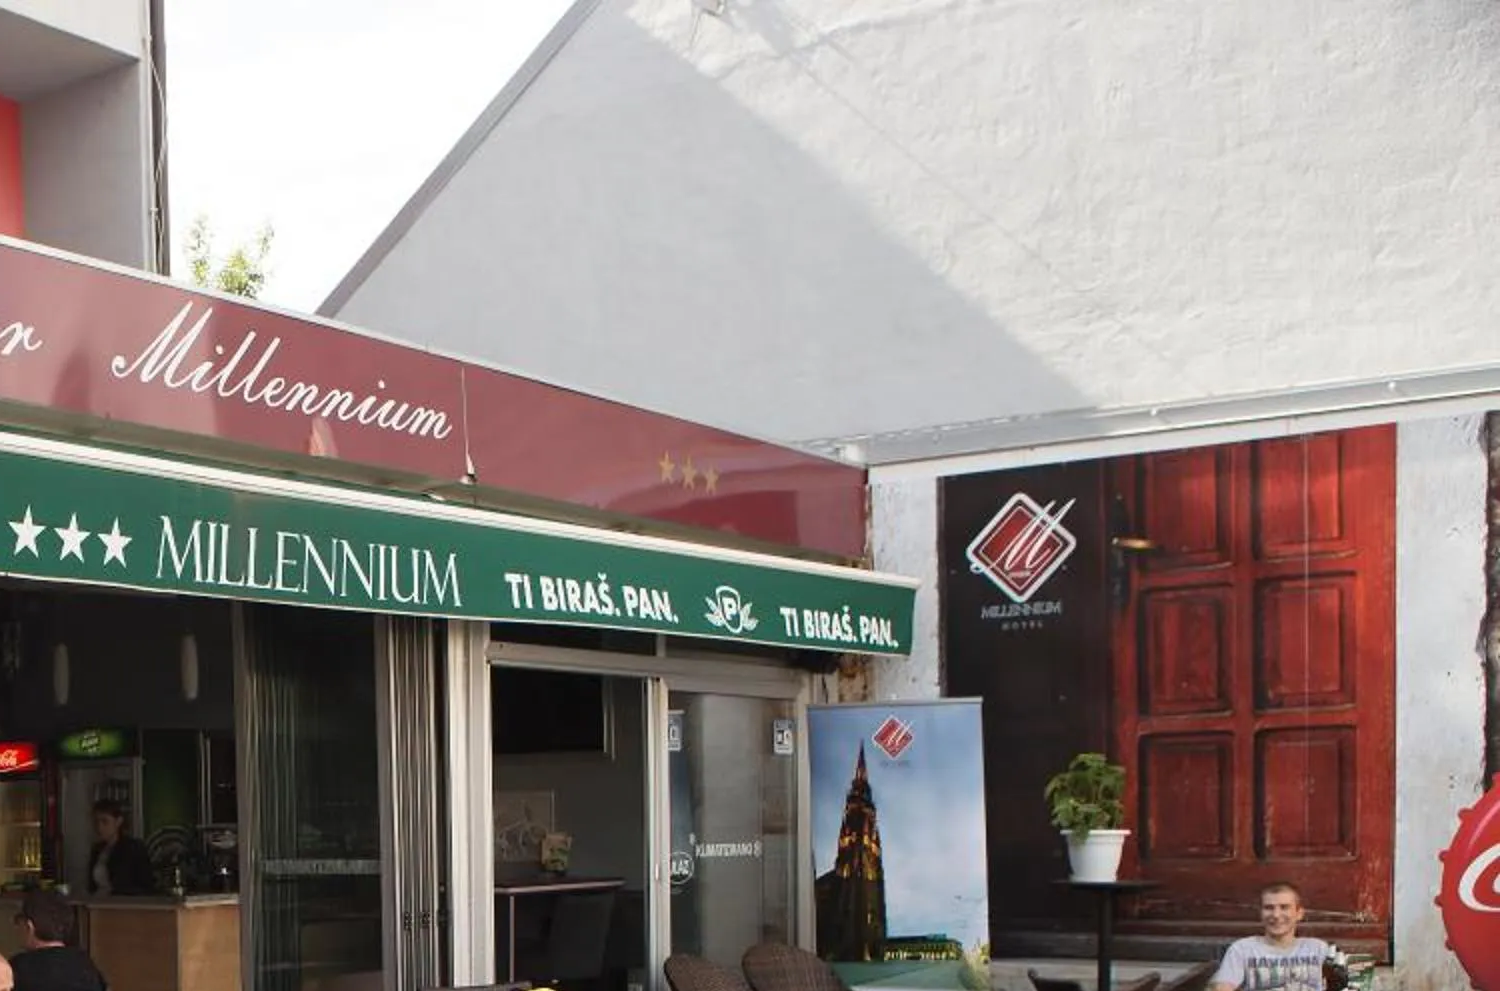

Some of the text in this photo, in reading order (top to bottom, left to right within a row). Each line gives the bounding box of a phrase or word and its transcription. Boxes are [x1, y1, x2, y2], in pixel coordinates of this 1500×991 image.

[111, 300, 453, 440] Millennium
[155, 515, 463, 608] MILLENNIUM
[504, 573, 680, 624] TI BIRAŠ. PAN.
[779, 605, 900, 648] TI BIRAŠ. PAN.
